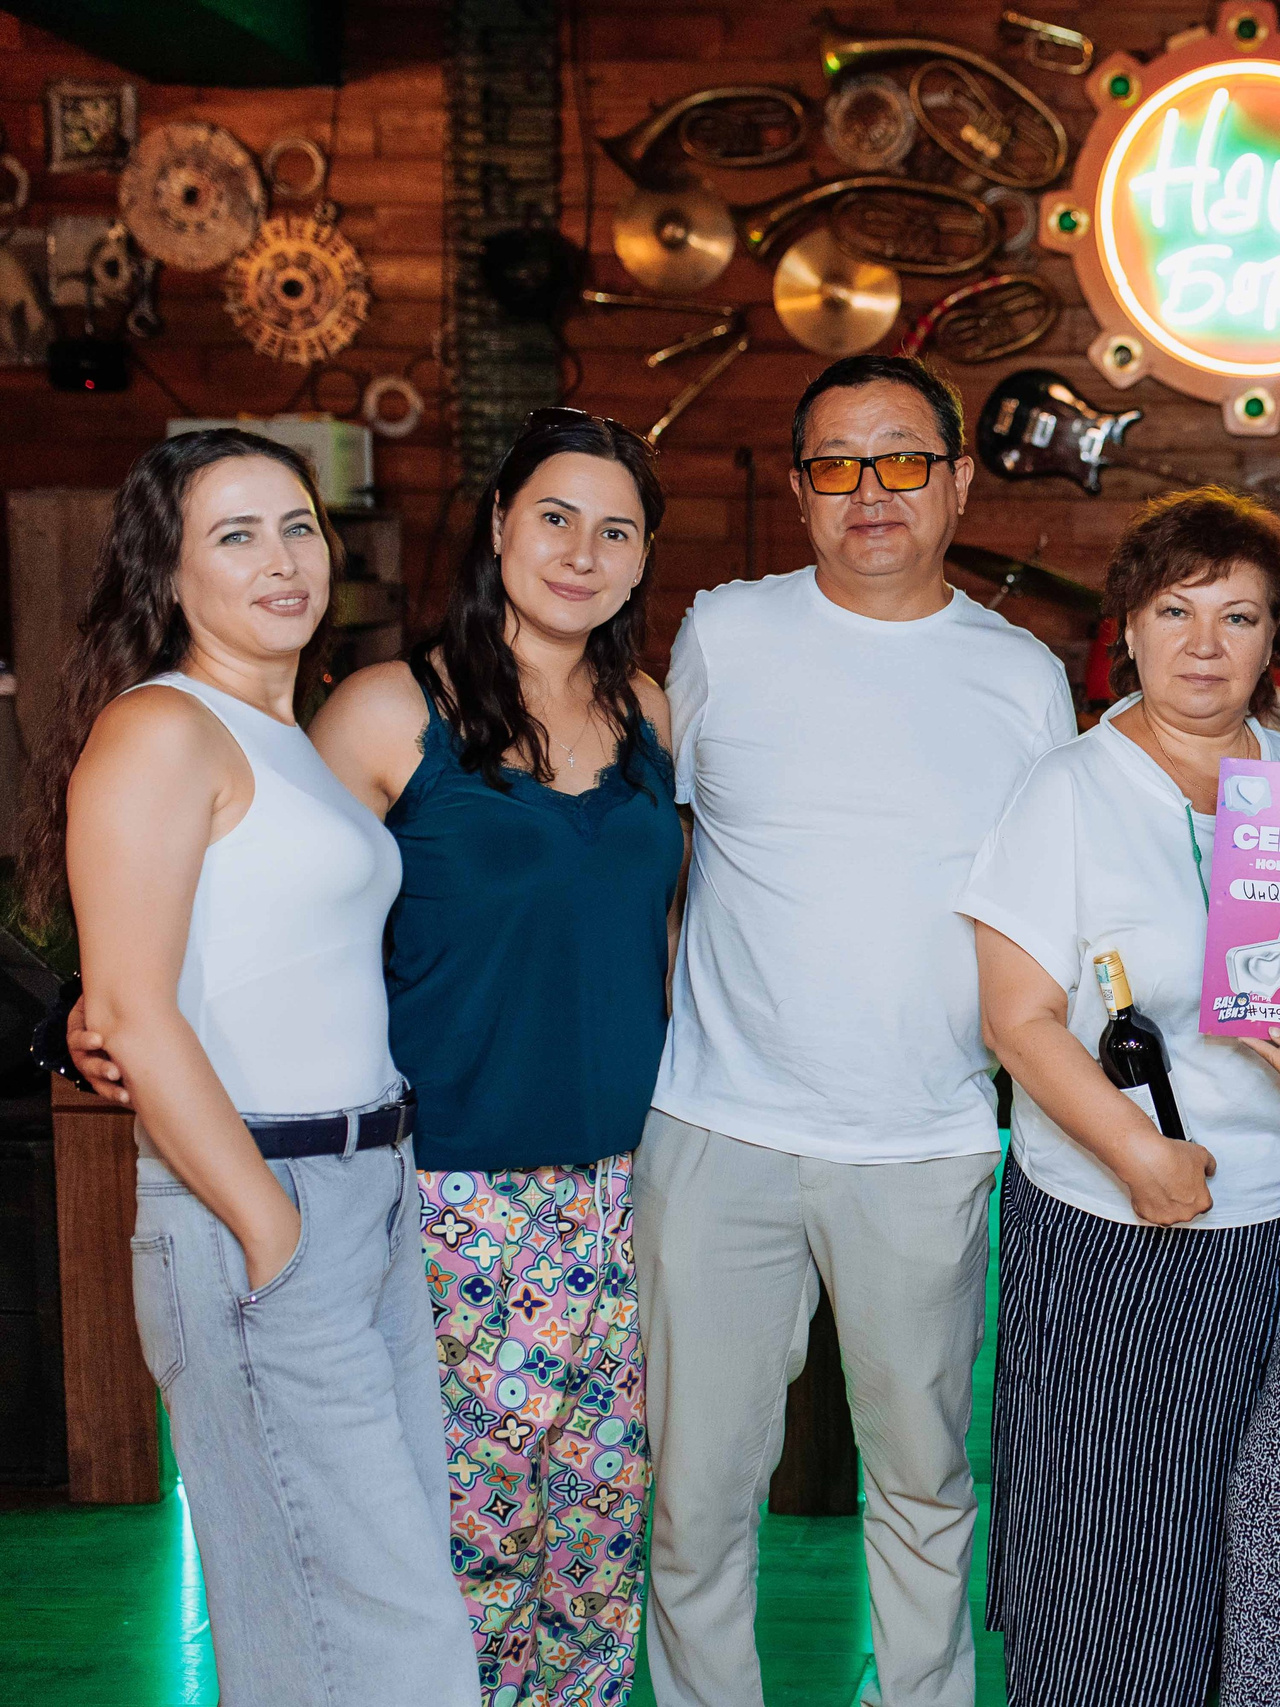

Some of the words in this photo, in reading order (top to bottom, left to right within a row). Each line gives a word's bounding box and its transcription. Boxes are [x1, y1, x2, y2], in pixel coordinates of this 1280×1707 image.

[1213, 996, 1237, 1010] ВАУ
[1251, 994, 1272, 1003] ИГРА
[1218, 1006, 1245, 1020] КВИЗ
